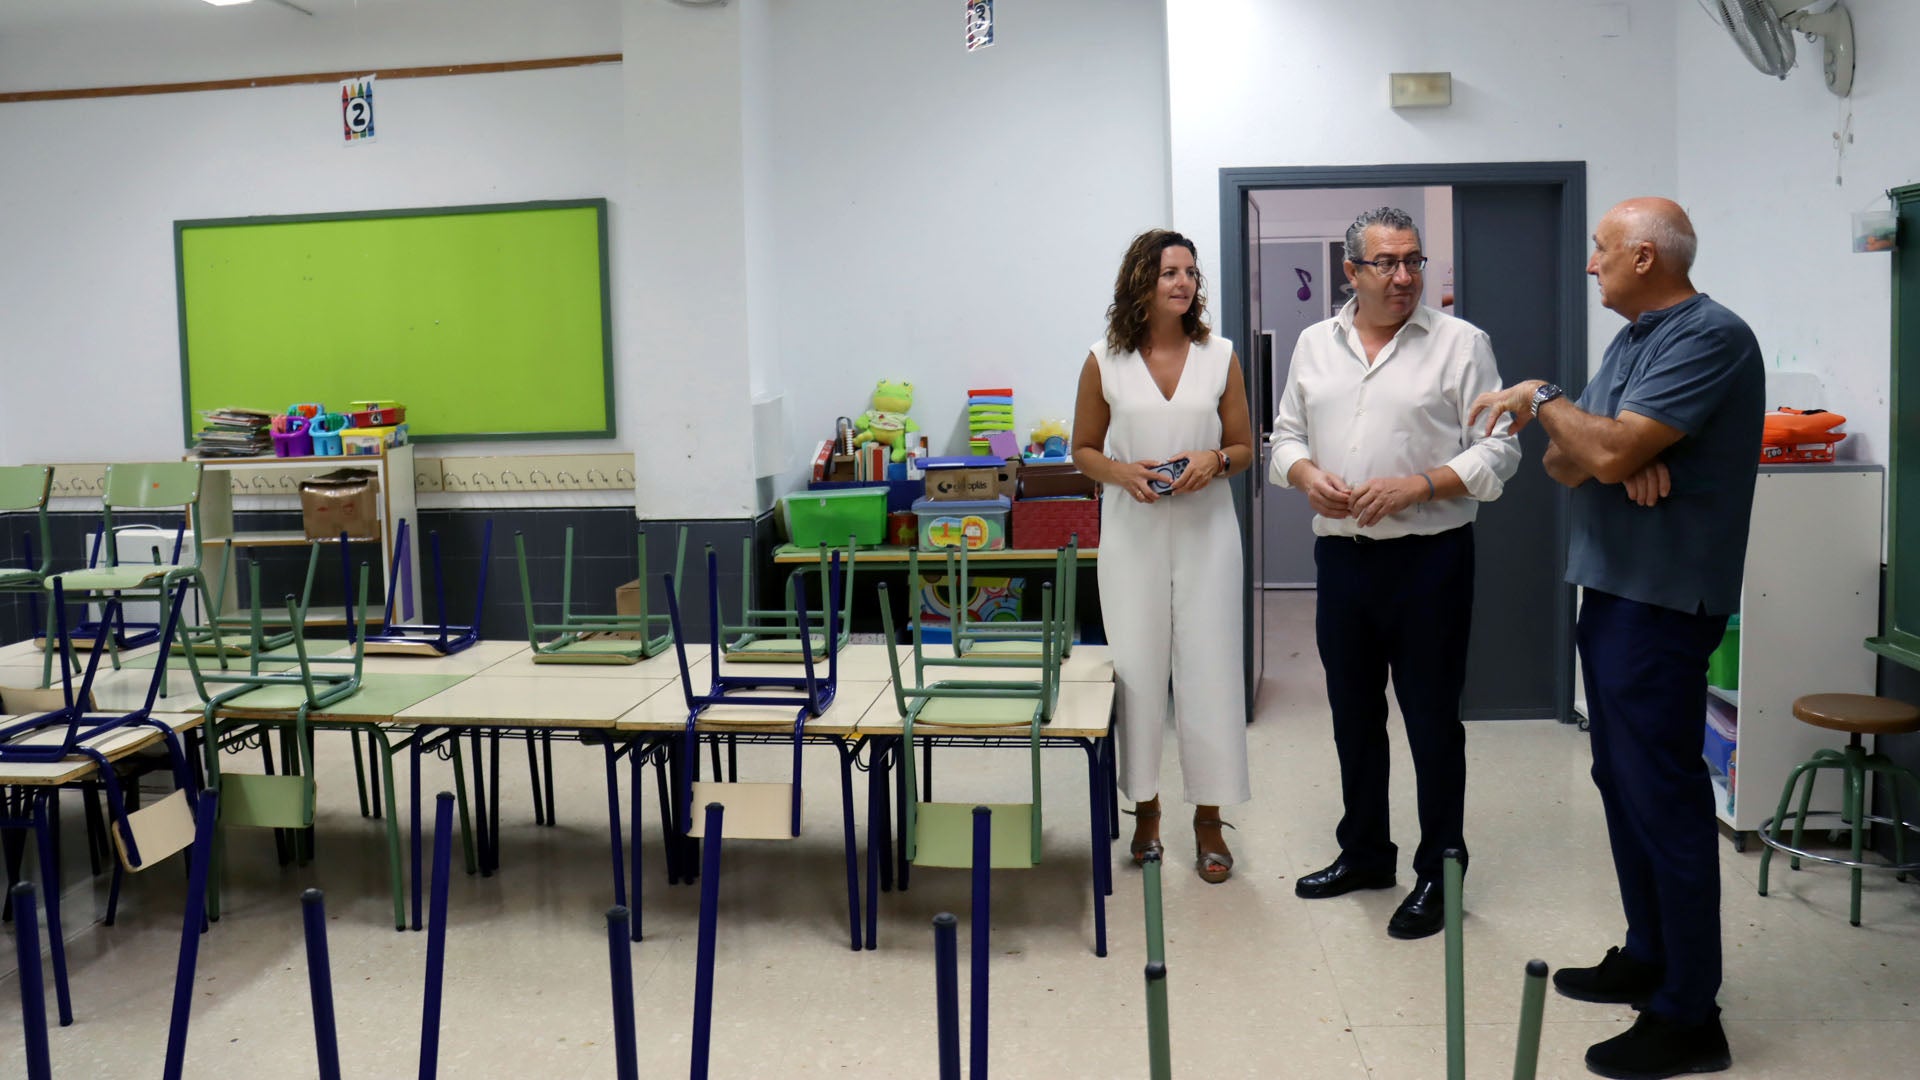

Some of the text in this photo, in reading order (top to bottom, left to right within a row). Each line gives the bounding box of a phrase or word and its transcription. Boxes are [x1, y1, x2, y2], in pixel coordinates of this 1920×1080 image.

[352, 103, 366, 127] 2
[372, 414, 379, 422] 4
[940, 521, 950, 538] 1
